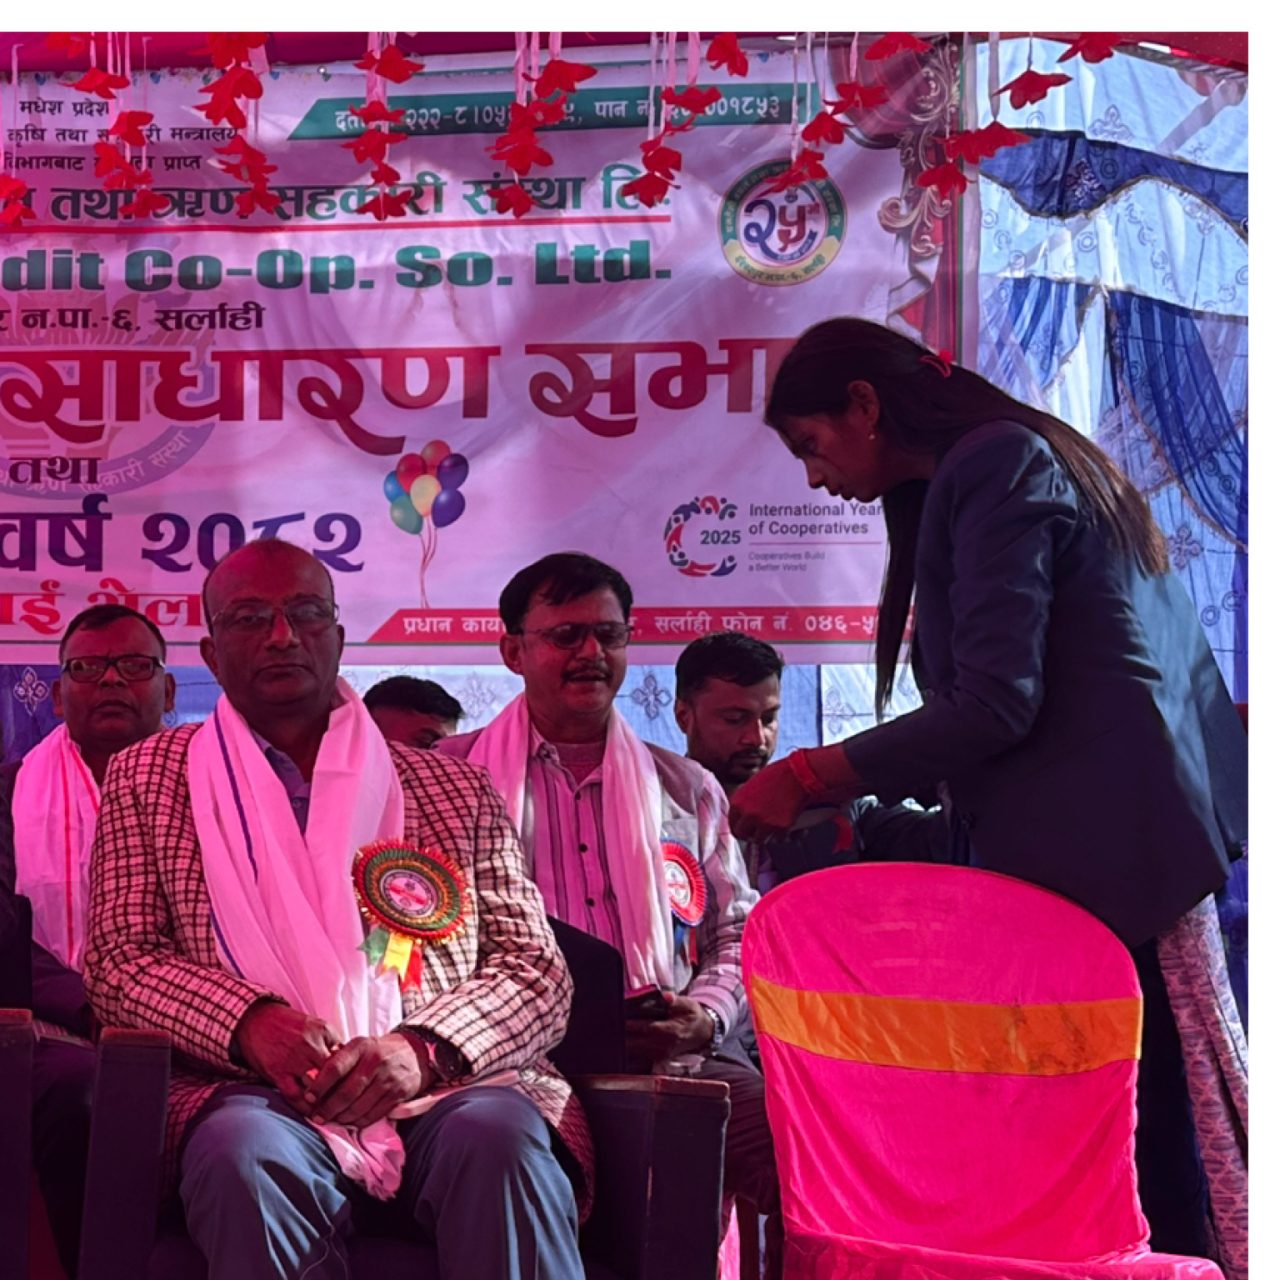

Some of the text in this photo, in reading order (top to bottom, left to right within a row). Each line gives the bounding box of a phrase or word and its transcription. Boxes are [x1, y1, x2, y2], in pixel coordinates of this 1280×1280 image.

[20, 97, 110, 117] मधेश प्रदेश
[594, 100, 628, 119] पान
[8, 123, 48, 148] कृषि
[55, 127, 96, 143] तथा
[163, 154, 205, 172] प्राप्त
[125, 246, 374, 295] Co-Op.
[395, 244, 514, 288] So.
[534, 238, 672, 285] Ltd.
[154, 300, 266, 332] सर्लाही
[8, 455, 101, 485] तथा
[749, 502, 883, 517] International Year
[700, 530, 741, 545] 2025
[748, 520, 869, 538] of Cooperatives
[403, 615, 453, 635] प्रधान
[655, 610, 712, 635] सर्लाही
[721, 610, 764, 634] फोन
